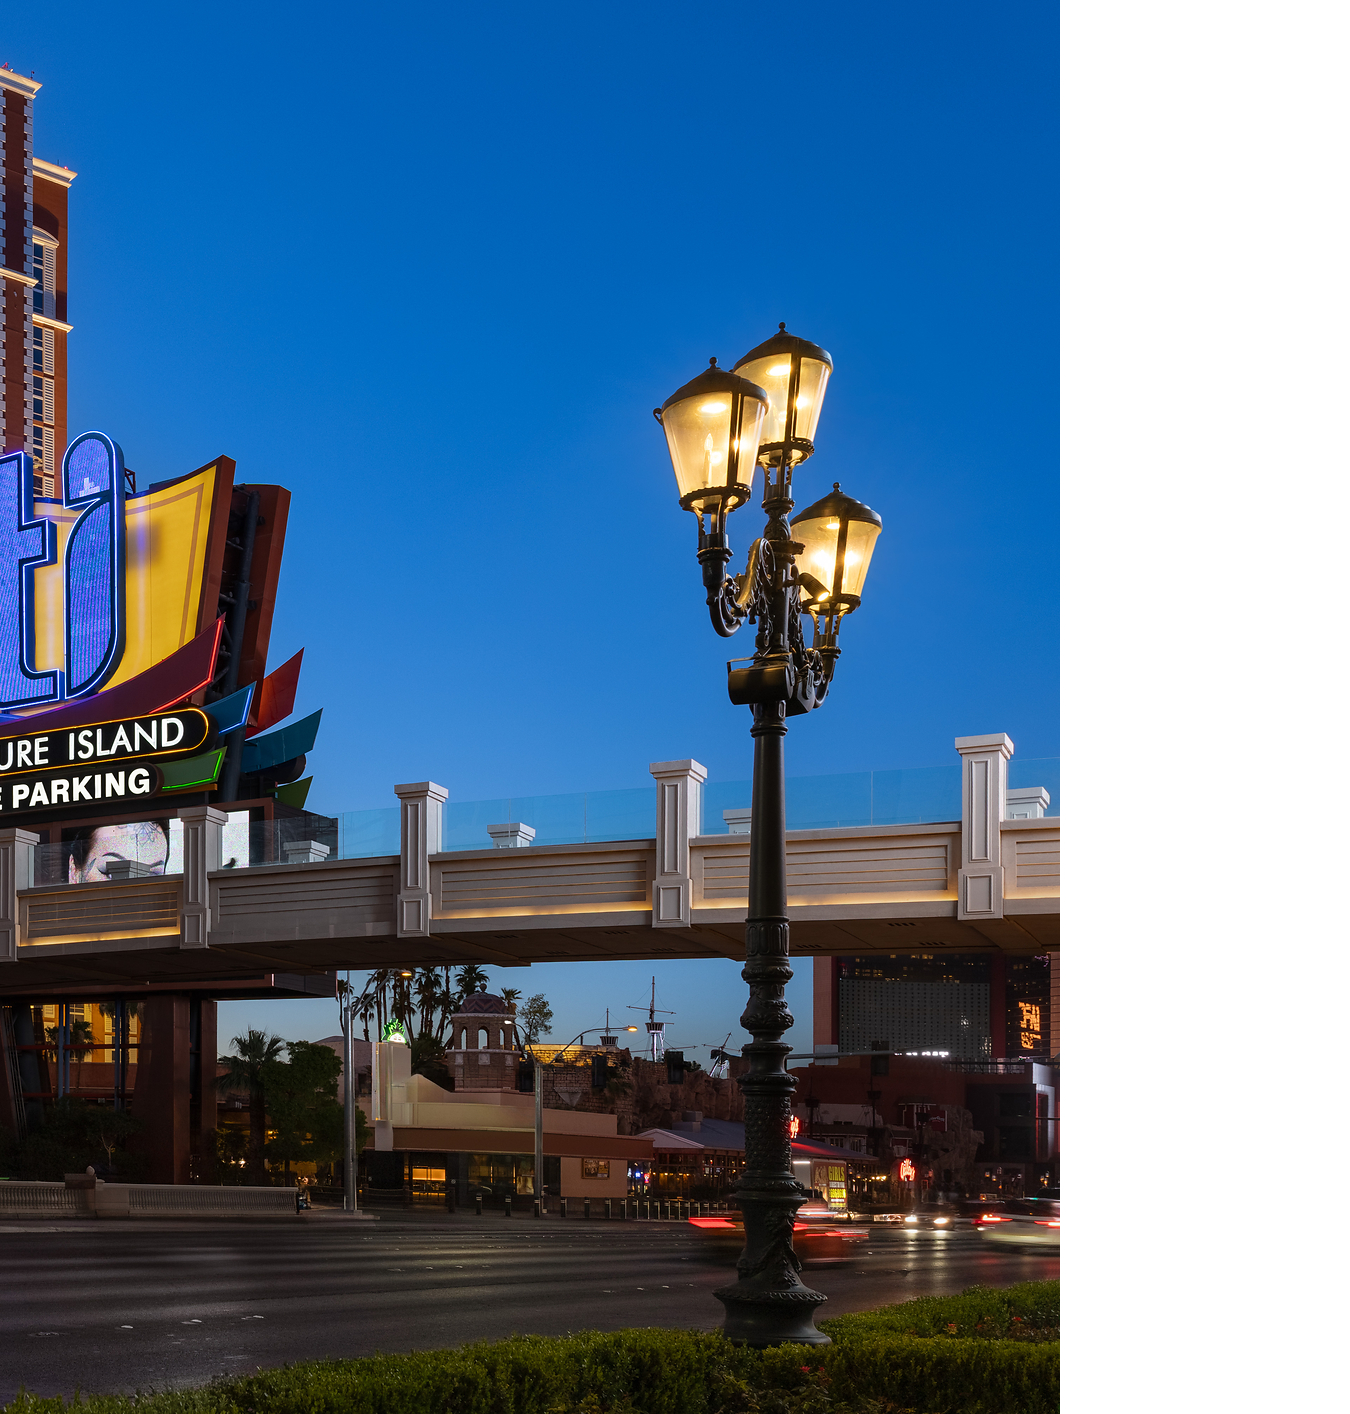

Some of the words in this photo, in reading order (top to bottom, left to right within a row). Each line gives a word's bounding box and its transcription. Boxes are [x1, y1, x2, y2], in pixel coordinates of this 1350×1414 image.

[68, 717, 185, 761] ISLAND
[12, 768, 150, 809] PARKING
[828, 1165, 845, 1181] GIRLS
